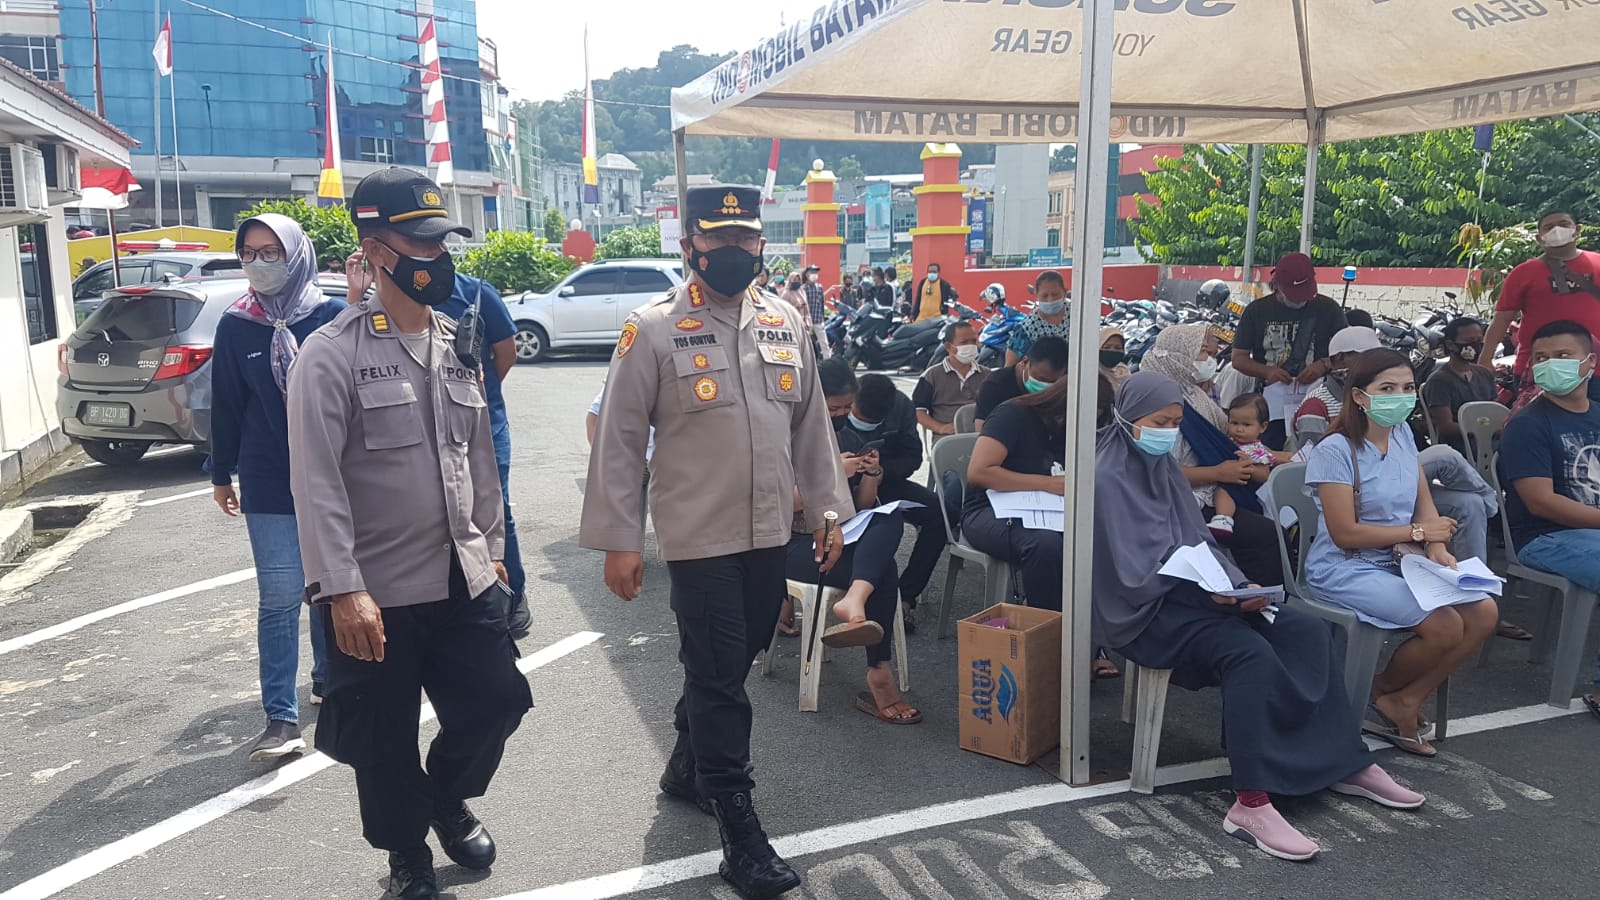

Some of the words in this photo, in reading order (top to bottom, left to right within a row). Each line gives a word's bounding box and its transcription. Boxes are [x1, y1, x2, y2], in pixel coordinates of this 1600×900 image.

[673, 336, 690, 349] YOS
[757, 329, 793, 342] POLRI
[360, 364, 401, 380] FELIX
[971, 658, 996, 725] AQUA
